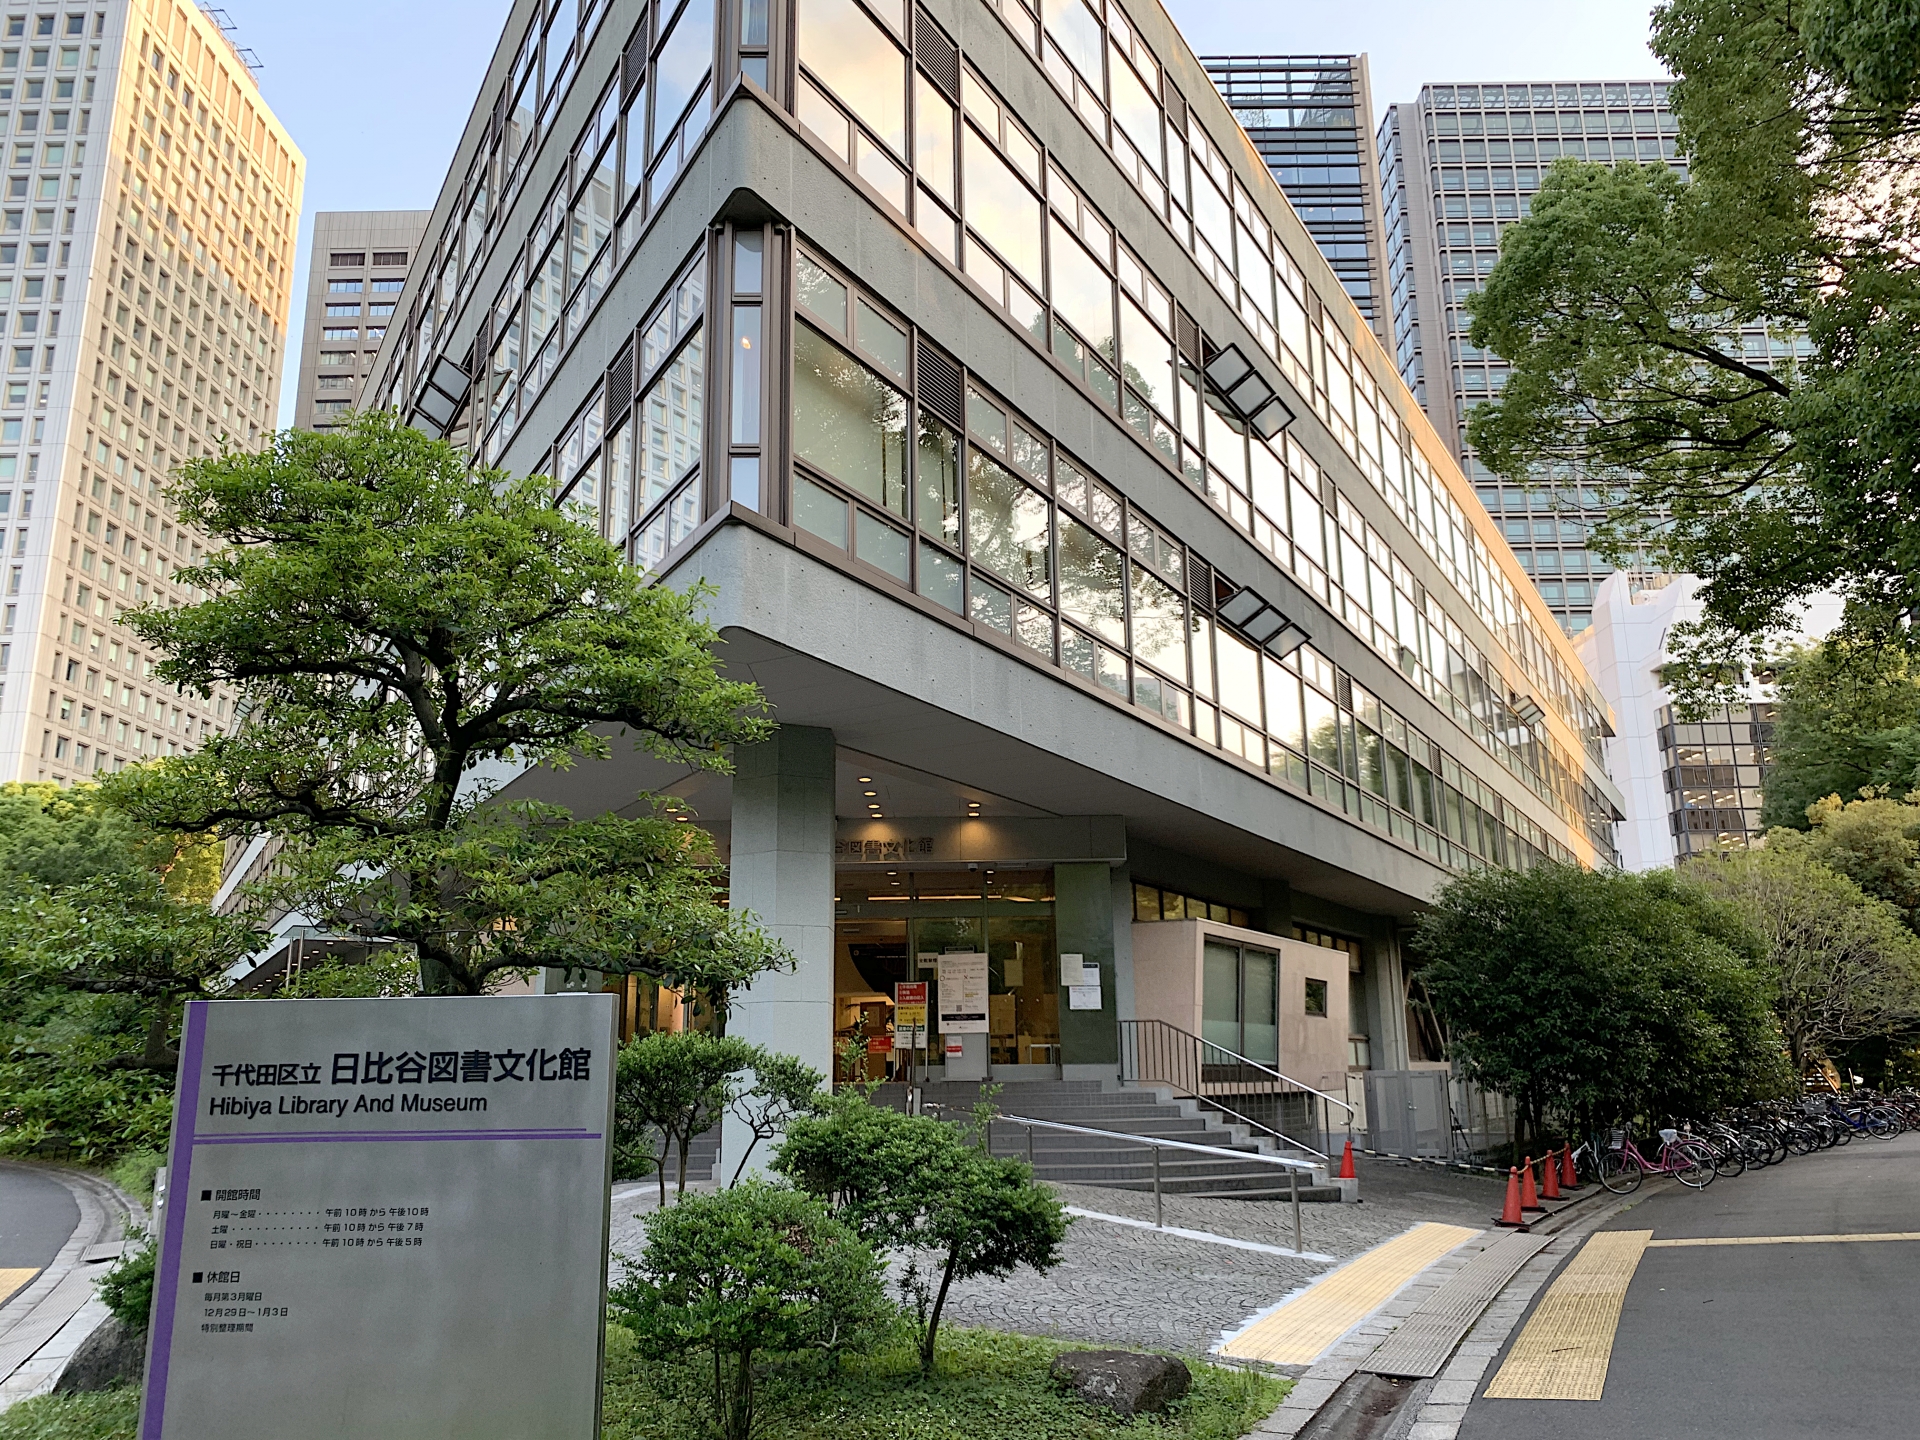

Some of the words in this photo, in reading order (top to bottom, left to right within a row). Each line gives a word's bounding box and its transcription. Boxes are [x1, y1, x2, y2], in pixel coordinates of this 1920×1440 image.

[212, 1063, 322, 1087] 千代田区立
[331, 1047, 591, 1085] 日比谷図書文化館
[210, 1097, 272, 1120] Hibiya
[279, 1096, 348, 1118] Library
[353, 1094, 394, 1113] And
[401, 1094, 487, 1112] Museum
[216, 1189, 261, 1201] 開館時間
[207, 1271, 240, 1283] 休館日
[205, 1292, 262, 1302] 毎月第3月曜日
[201, 1323, 253, 1333] 特別整理期間
